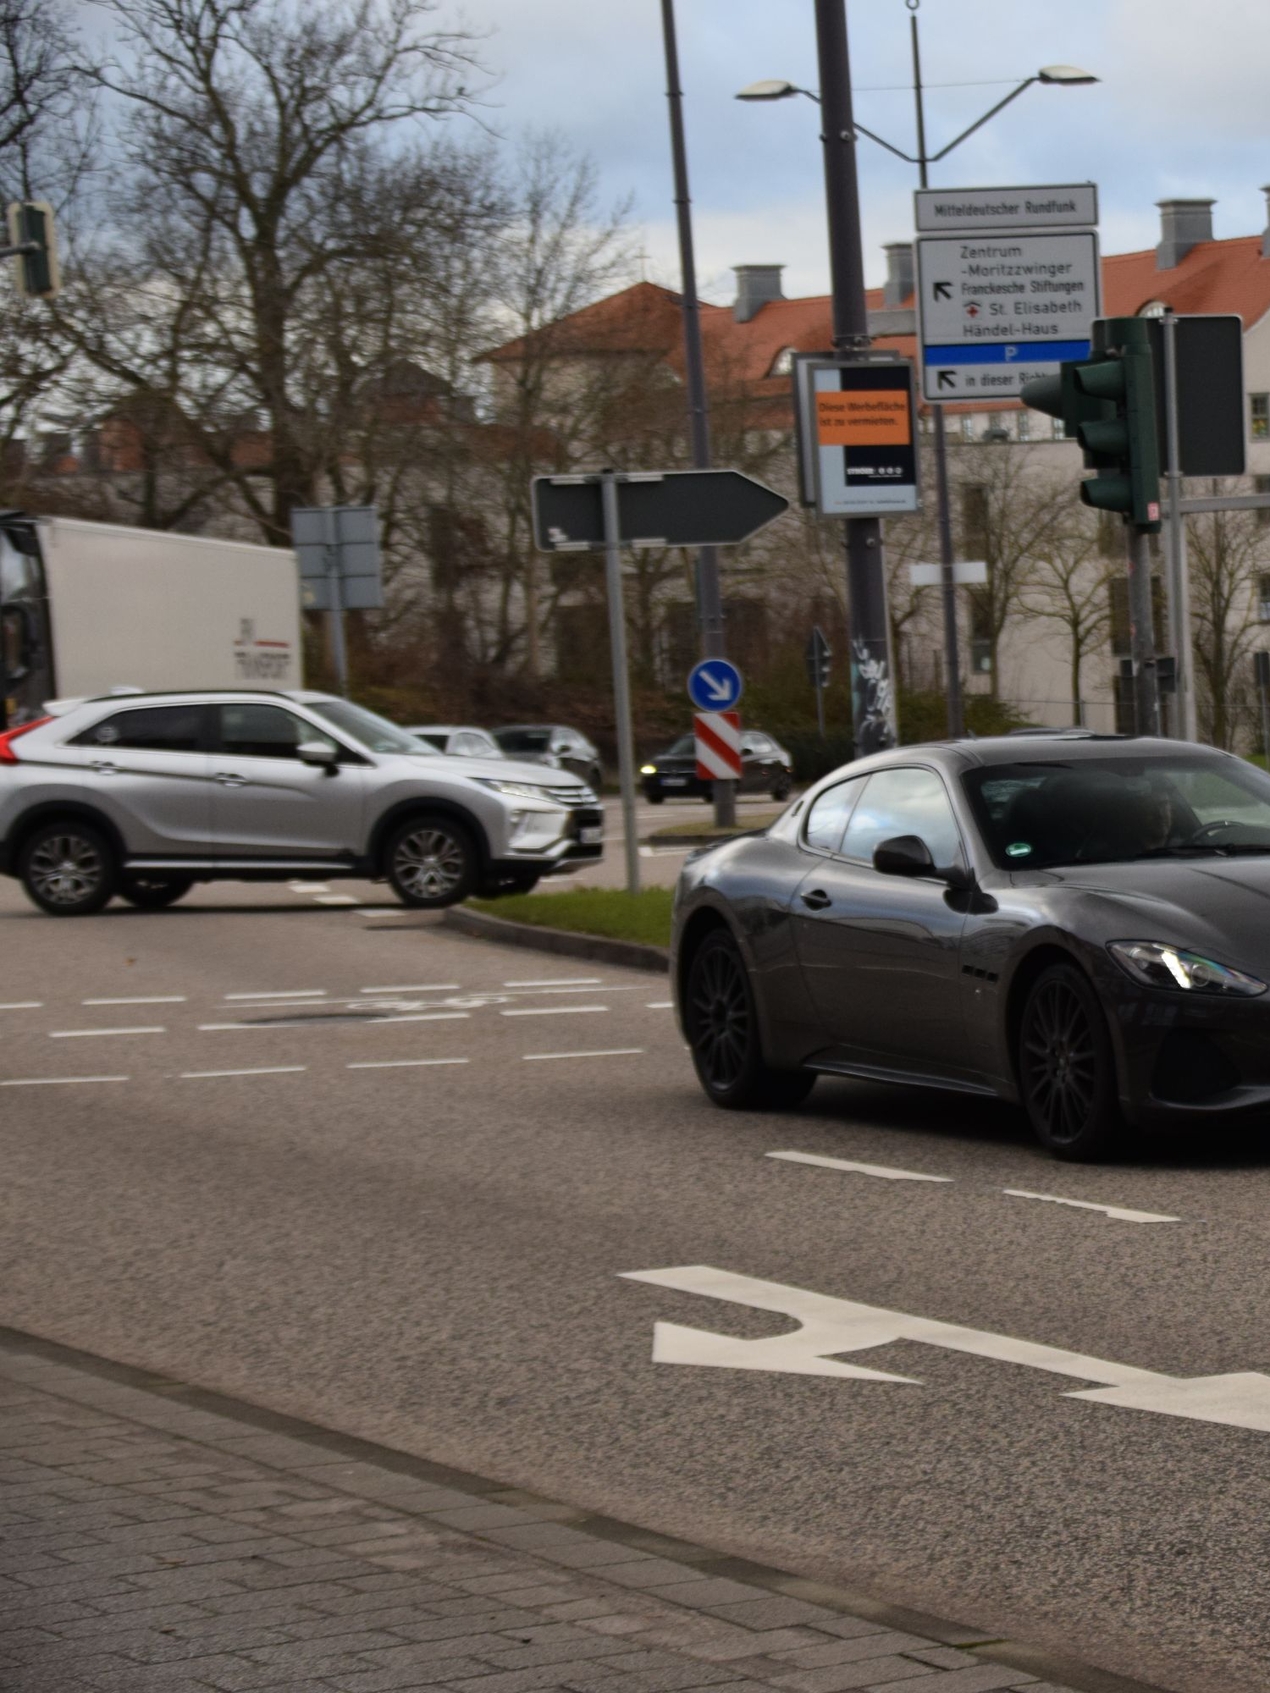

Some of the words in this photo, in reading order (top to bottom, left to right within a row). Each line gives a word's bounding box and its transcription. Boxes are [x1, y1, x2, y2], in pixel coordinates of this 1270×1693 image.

[934, 202, 1020, 217] Mitteldeutscher
[1025, 200, 1076, 215] Rundfunk
[960, 246, 1022, 260] Zentrum
[961, 282, 1025, 296] Franckesche
[1030, 280, 1084, 296] Stiftungen
[989, 303, 1007, 317] St.
[1014, 300, 1083, 315] Elisabeth
[963, 322, 1059, 338] Händel-Haus
[1004, 346, 1018, 362] P
[965, 375, 976, 387] in
[981, 373, 1014, 387] dieser
